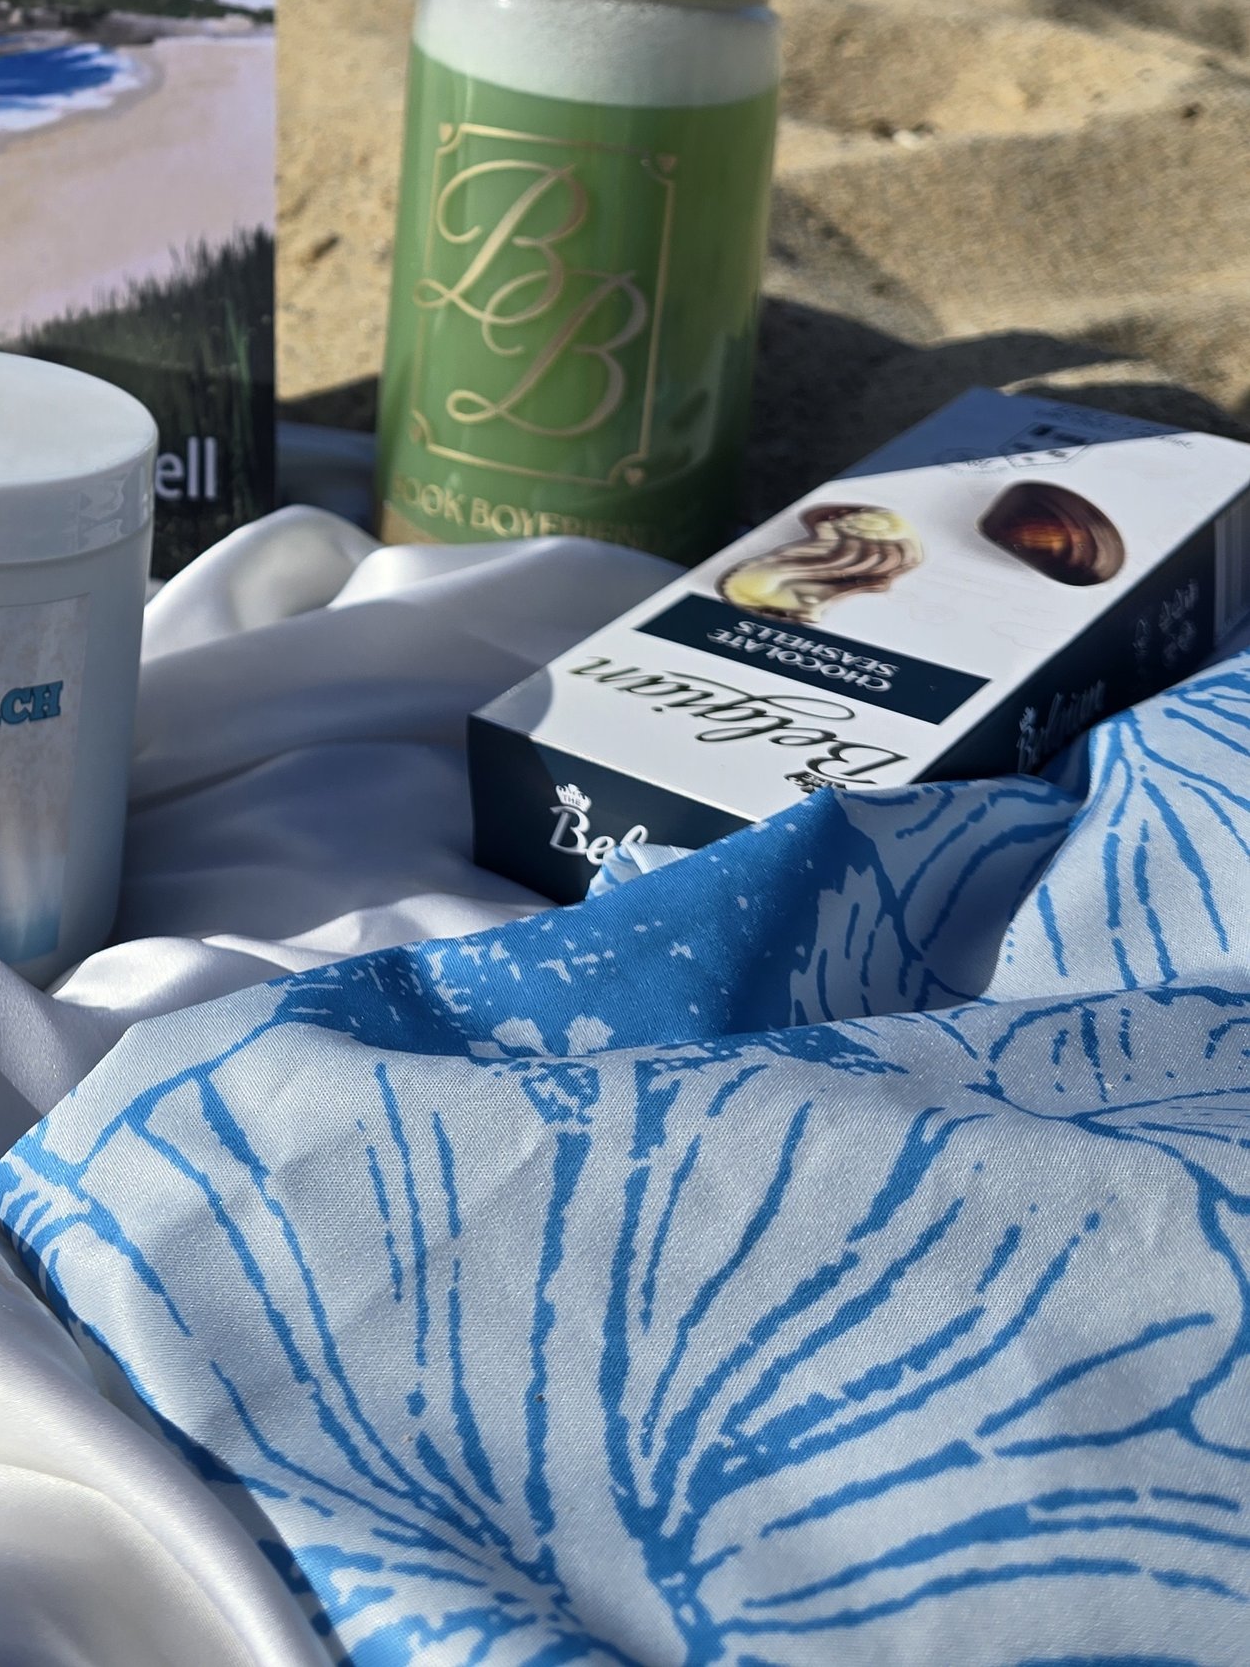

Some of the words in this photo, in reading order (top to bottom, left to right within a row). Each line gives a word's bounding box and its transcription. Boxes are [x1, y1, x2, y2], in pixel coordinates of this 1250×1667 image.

[707, 627, 892, 691] CHOCOLATE
[734, 620, 900, 676] SEASHELLS
[567, 655, 909, 786] Belgian
[561, 793, 582, 807] THE
